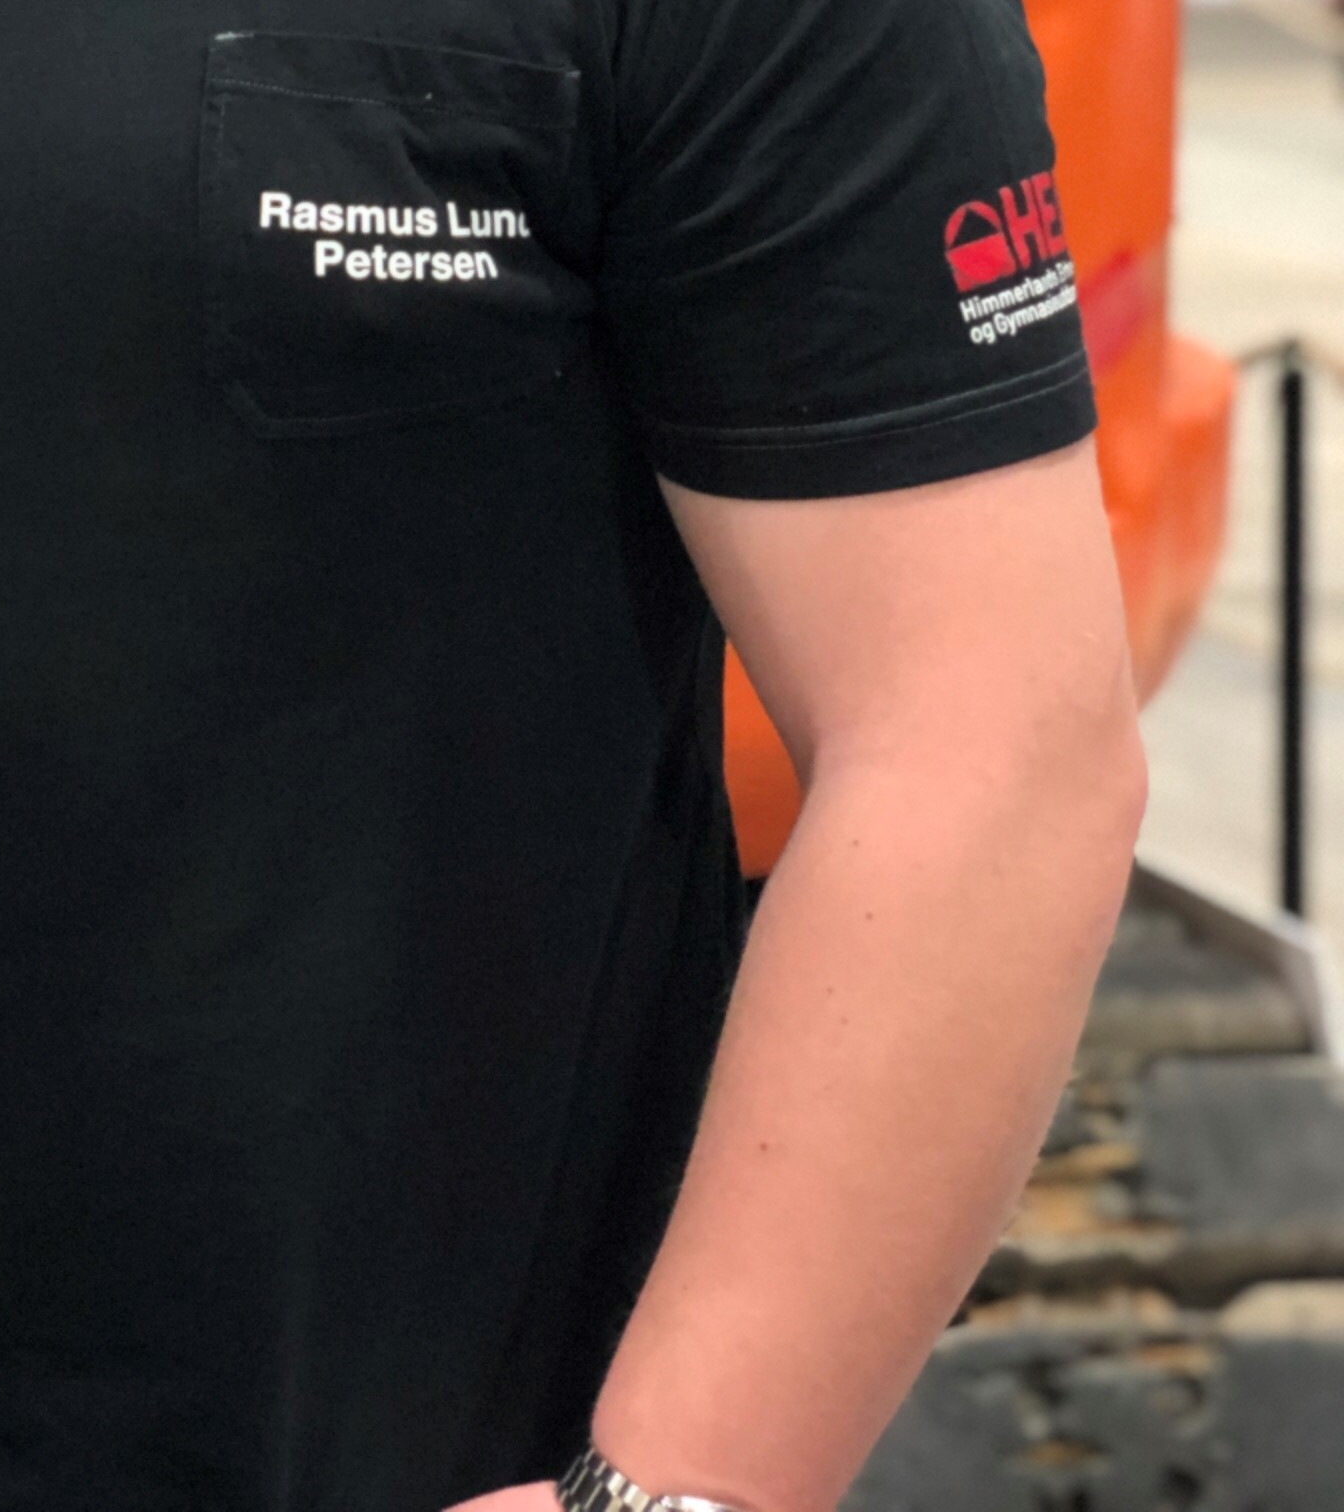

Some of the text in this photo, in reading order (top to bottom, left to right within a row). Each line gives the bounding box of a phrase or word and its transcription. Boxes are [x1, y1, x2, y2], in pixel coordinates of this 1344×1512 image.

[259, 191, 438, 236] Rasmus
[314, 240, 498, 281] Petersen
[969, 321, 997, 345] og
